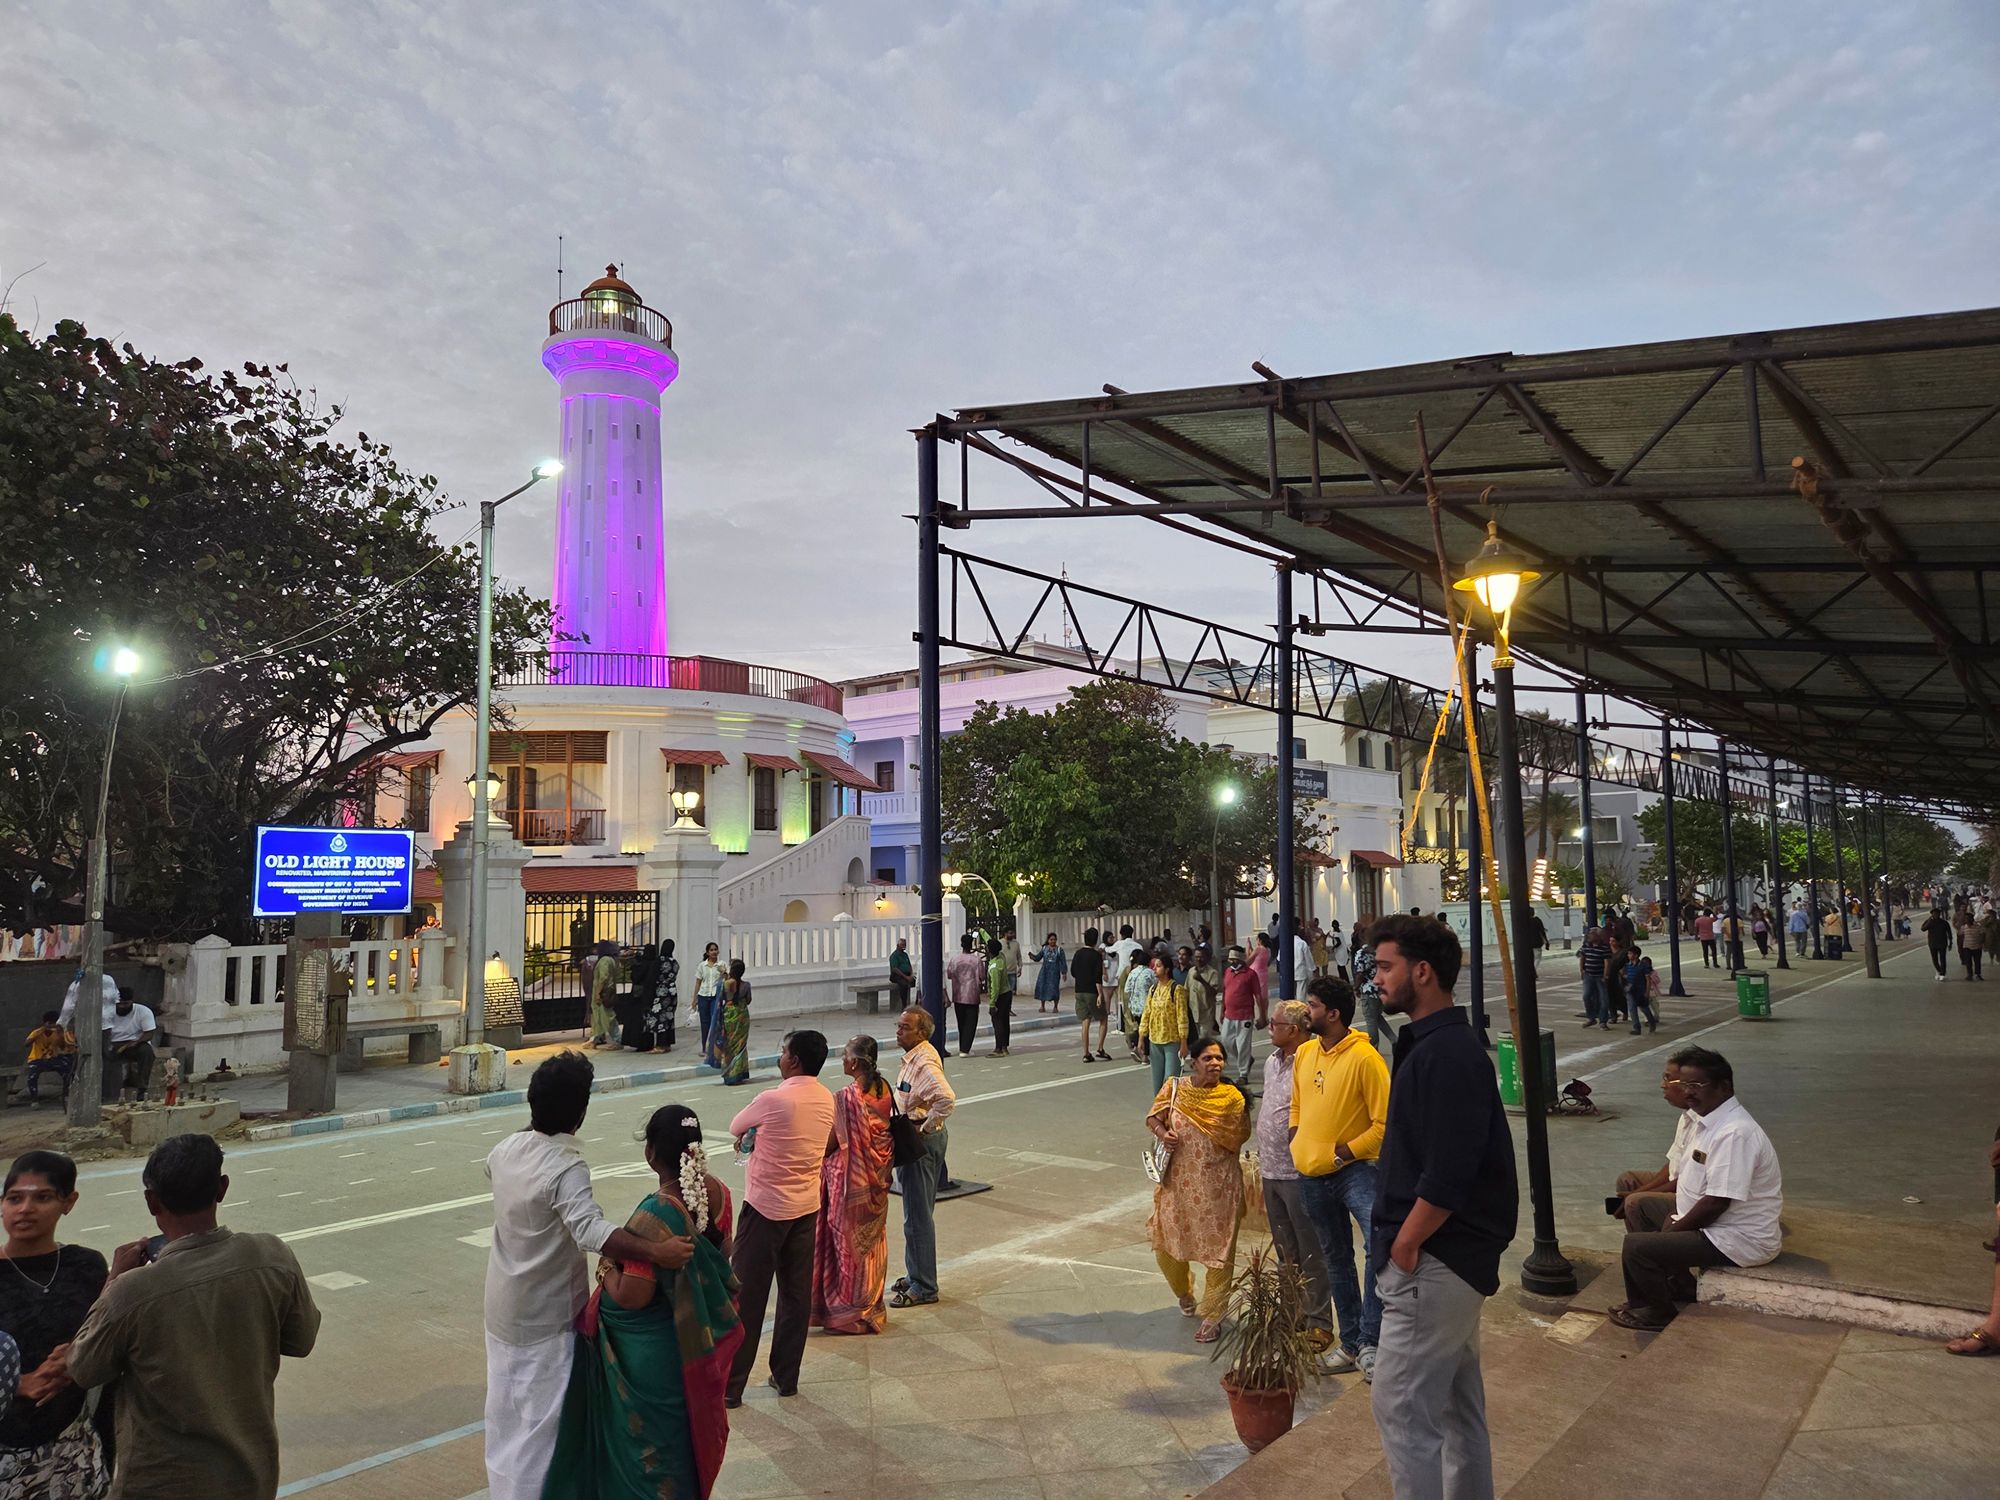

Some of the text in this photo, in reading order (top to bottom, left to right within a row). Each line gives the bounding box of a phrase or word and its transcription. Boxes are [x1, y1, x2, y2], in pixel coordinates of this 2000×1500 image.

[264, 854, 405, 869] OLD LIGHT HOUSE
[275, 869, 313, 877] RENOVATED,
